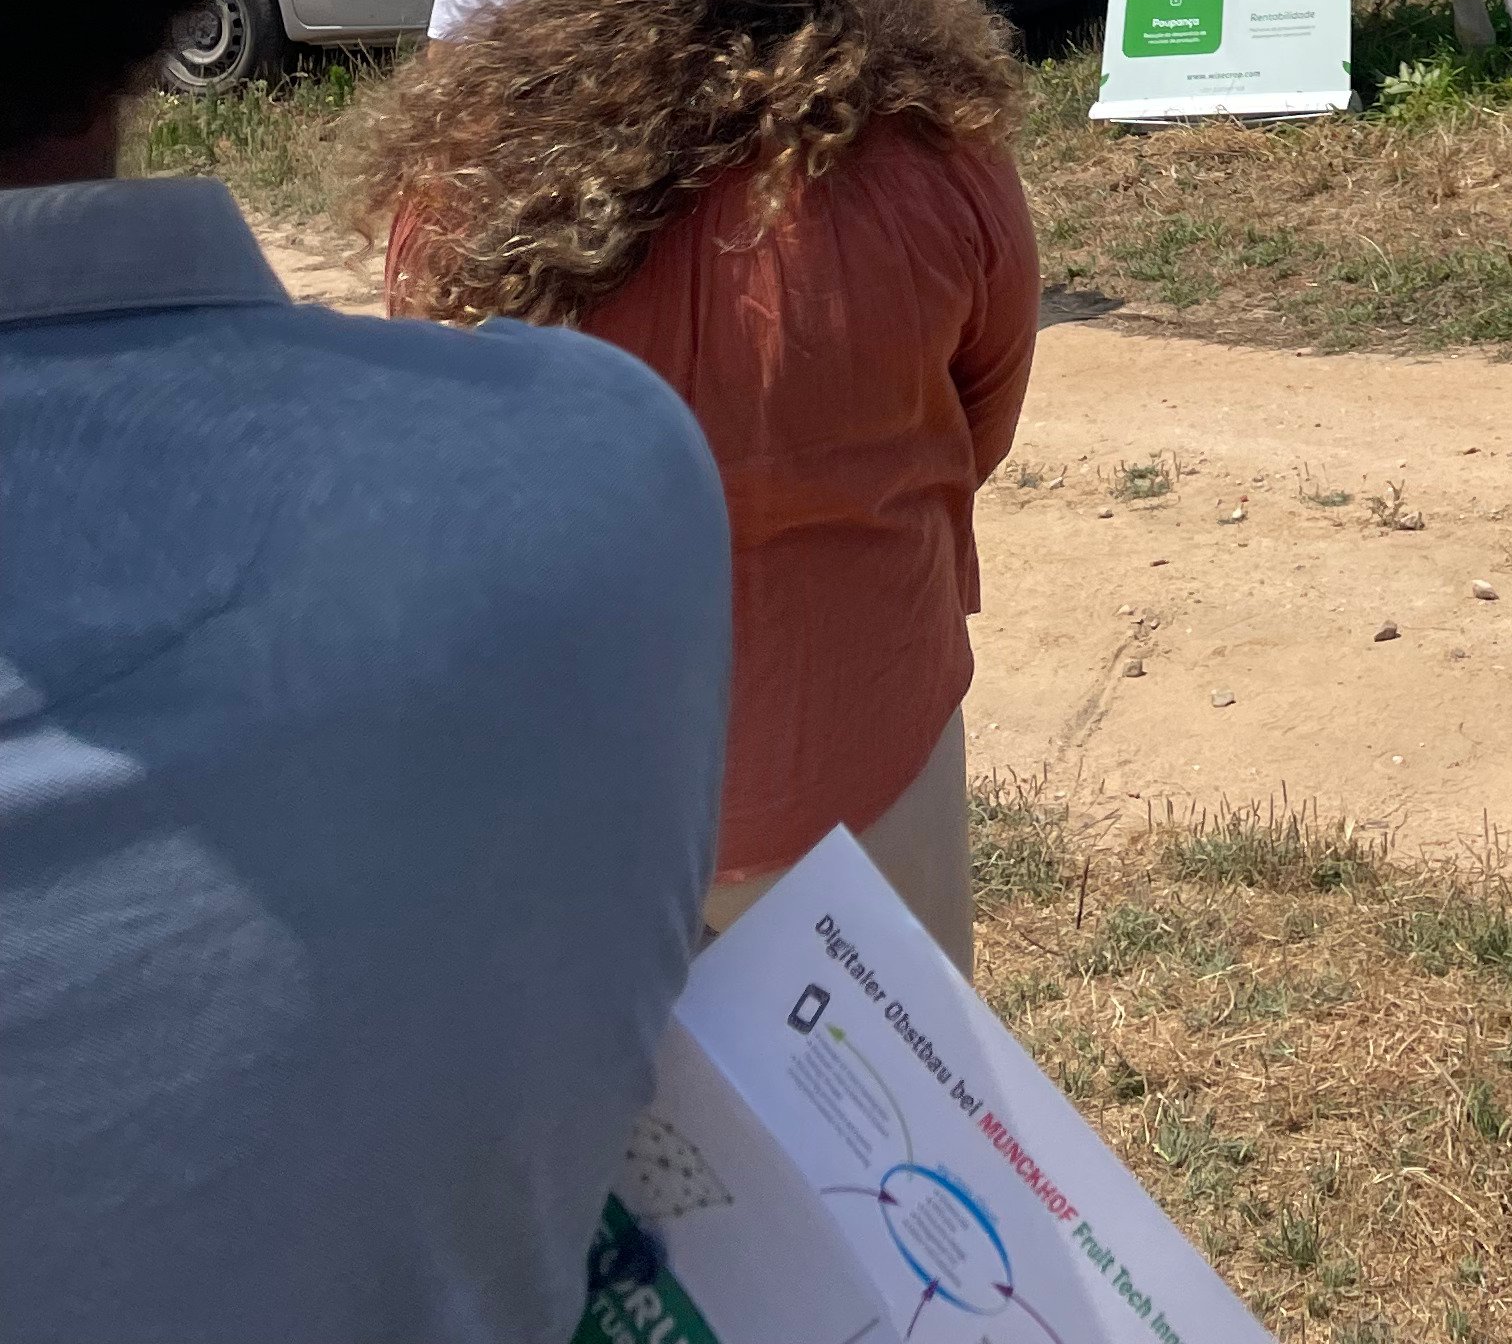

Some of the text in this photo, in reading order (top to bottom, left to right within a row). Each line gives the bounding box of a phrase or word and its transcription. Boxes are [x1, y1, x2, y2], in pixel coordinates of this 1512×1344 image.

[814, 914, 887, 1003] Digitaler
[884, 1000, 952, 1085] Obstbau
[951, 1079, 984, 1117] bei
[977, 1111, 1080, 1222] MUNCKHOF
[1072, 1220, 1116, 1274] Fruit
[1112, 1264, 1152, 1319] Tech
